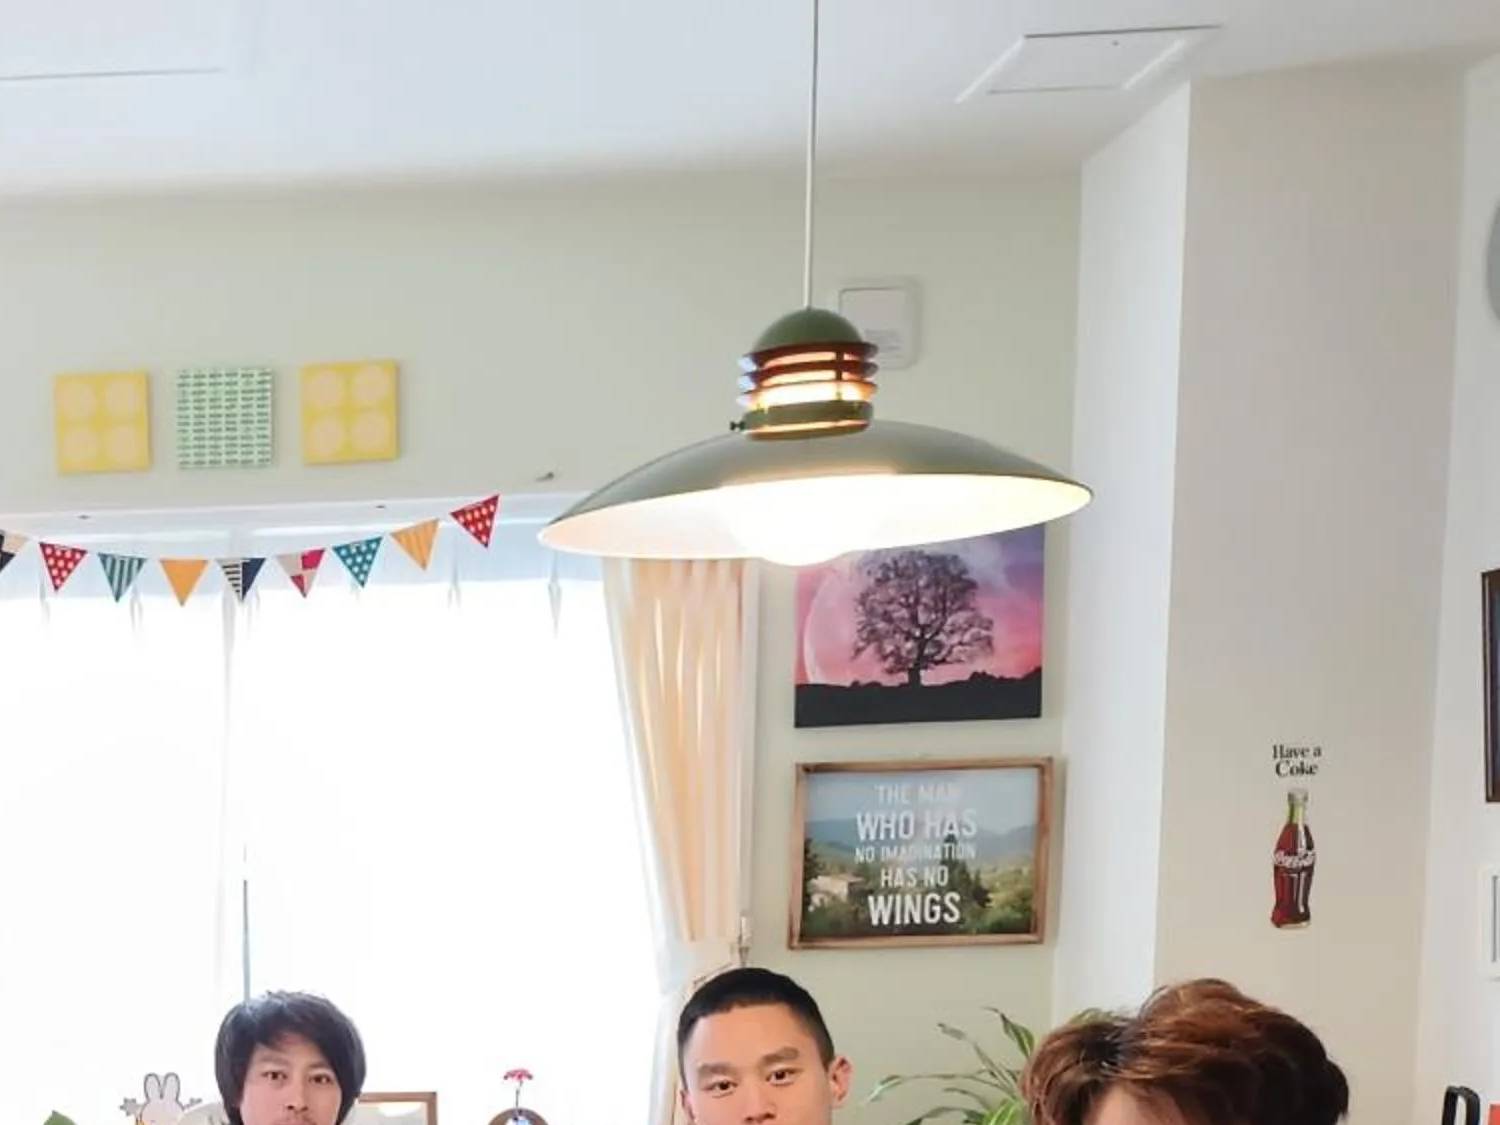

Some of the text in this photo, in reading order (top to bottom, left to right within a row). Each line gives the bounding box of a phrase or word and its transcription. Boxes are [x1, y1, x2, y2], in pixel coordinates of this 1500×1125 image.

[1272, 744, 1322, 759] Have a
[1275, 760, 1319, 777] Coke
[875, 782, 962, 805] THE MAN
[856, 808, 978, 841] WHO HAS
[855, 841, 977, 863] NO IMAGINATION
[880, 866, 949, 889] HAS NO
[867, 891, 962, 928] WINGS
